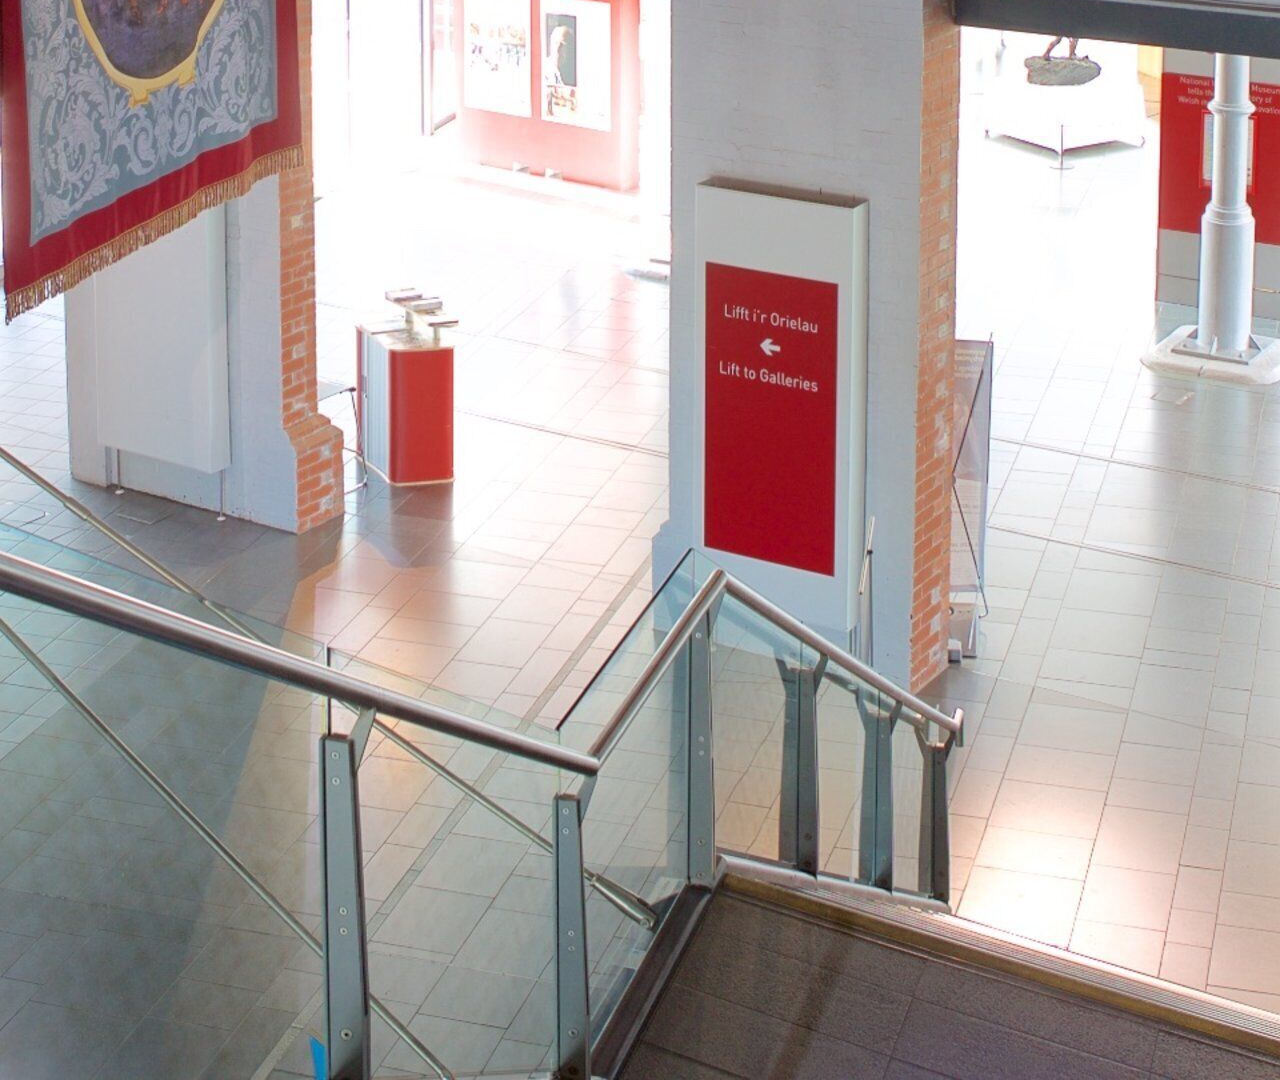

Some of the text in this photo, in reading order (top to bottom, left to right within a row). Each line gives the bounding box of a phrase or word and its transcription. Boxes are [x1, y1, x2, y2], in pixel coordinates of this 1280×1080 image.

[1180, 76, 1210, 87] National
[1177, 95, 1199, 105] Welsh
[1188, 87, 1203, 96] tells
[1264, 96, 1272, 104] of
[724, 303, 749, 321] Lifft
[770, 312, 818, 334] Orielau
[719, 360, 818, 392] Lift to Galleries
